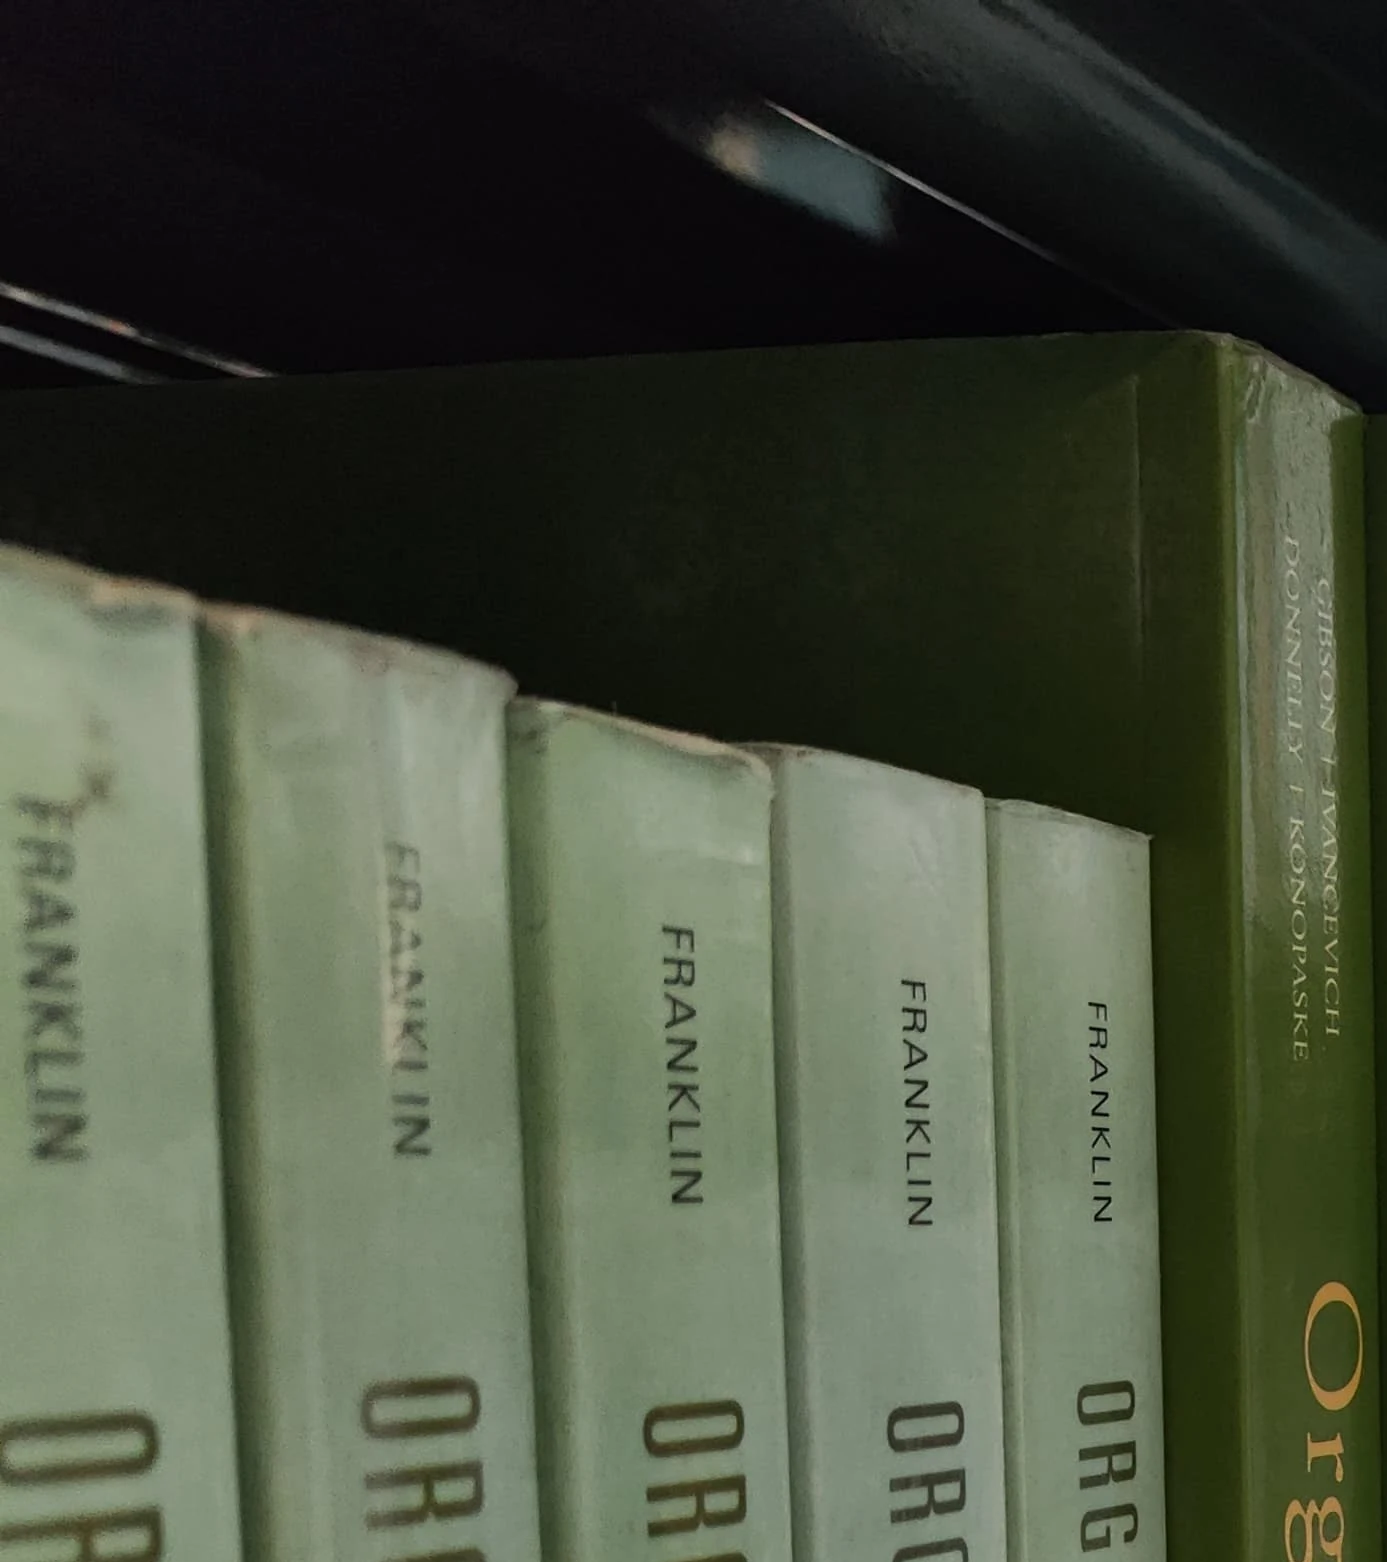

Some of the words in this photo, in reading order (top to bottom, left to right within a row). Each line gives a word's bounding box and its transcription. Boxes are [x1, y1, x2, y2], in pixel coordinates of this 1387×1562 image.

[1283, 535, 1304, 759] DONNELLY
[1319, 575, 1336, 734] GIBSON
[15, 795, 91, 1166] FRANKLIN
[384, 840, 433, 1159] FRANKLIN
[1290, 817, 1310, 1062] KONOPASKE
[1319, 783, 1340, 1038] IVANCEVICH
[660, 923, 704, 1206] FRANKLIN
[900, 977, 934, 1228] FRANKLIN
[1086, 1000, 1113, 1223] FRANKLIN
